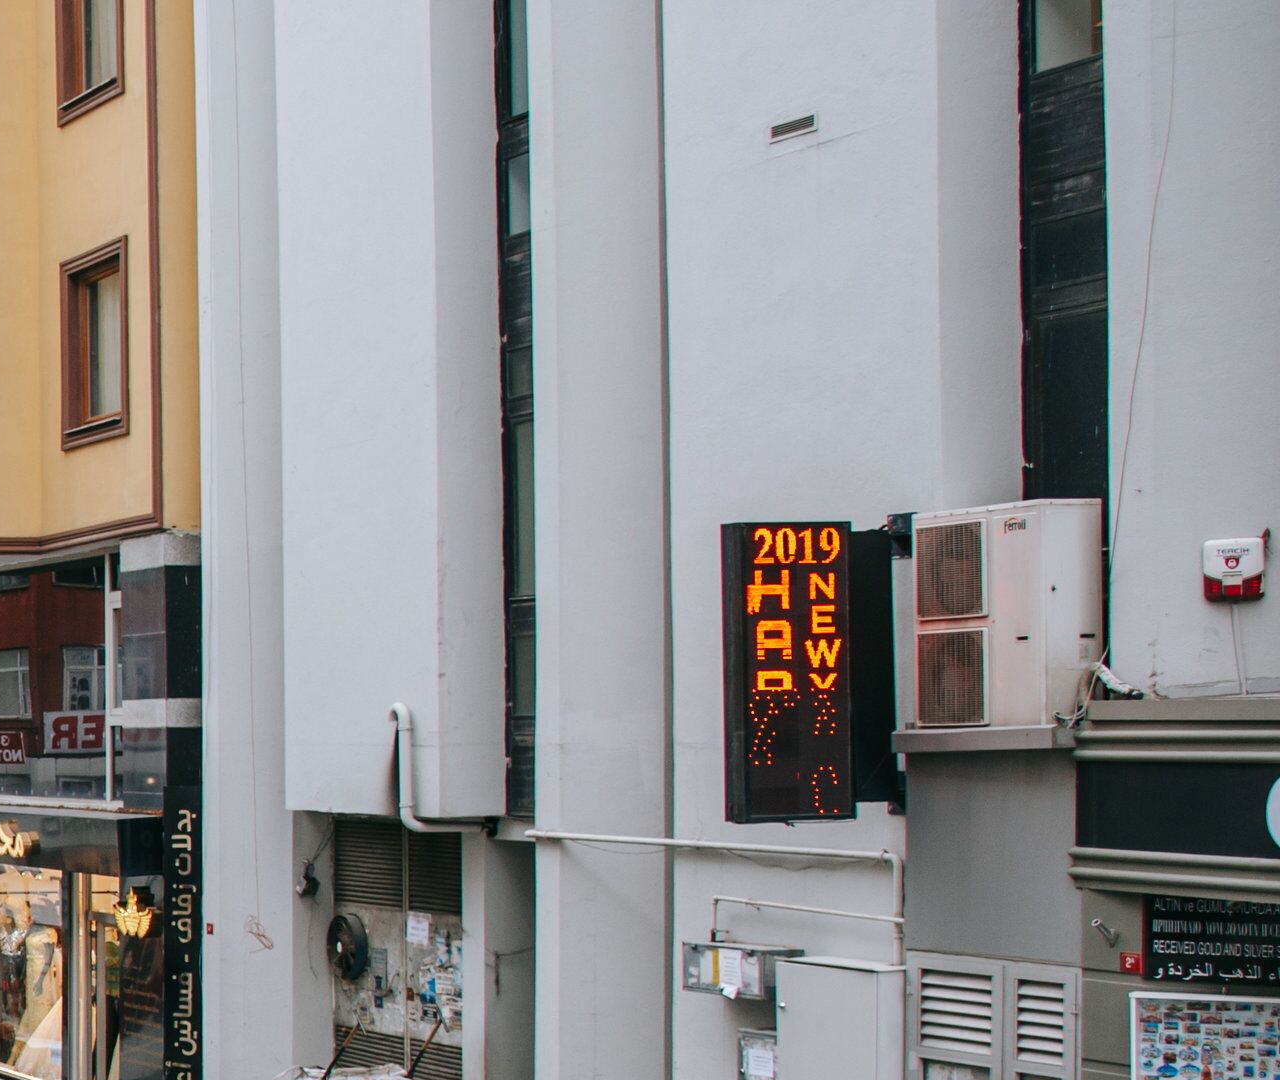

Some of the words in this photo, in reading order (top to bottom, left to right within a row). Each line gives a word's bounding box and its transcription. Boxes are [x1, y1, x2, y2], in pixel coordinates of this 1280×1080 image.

[754, 527, 840, 564] 2019
[1153, 939, 1195, 954] RECEIVED
[1197, 941, 1222, 956] GOLD
[1224, 943, 1241, 957] AND
[1243, 943, 1274, 958] SILVER
